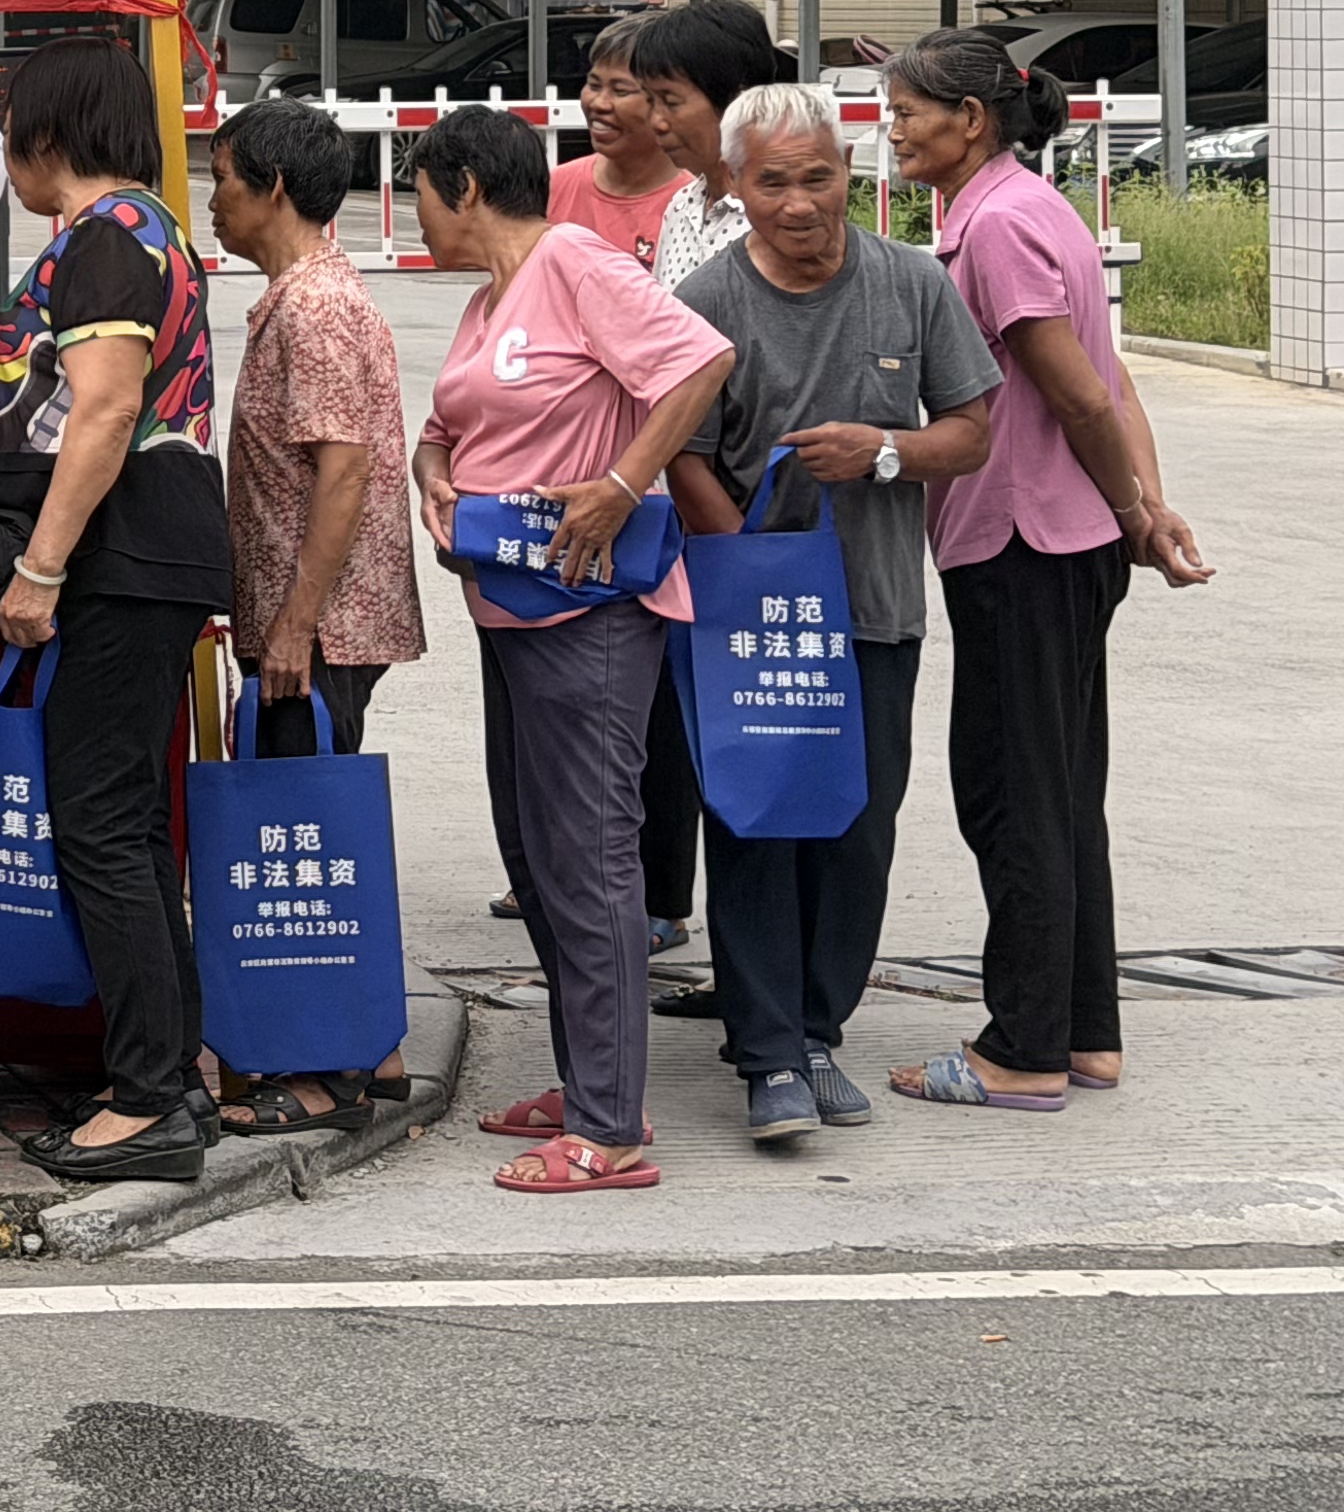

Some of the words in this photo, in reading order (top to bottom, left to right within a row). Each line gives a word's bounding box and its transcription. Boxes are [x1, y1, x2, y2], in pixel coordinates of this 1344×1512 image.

[493, 326, 528, 381] C
[762, 595, 824, 624] 防范
[729, 631, 845, 659] 非法集资
[733, 691, 845, 707] 0766-8612902
[260, 823, 322, 853] 防范
[229, 859, 357, 890] 非法集资
[257, 900, 332, 918] 举报电话:
[232, 920, 361, 939] 0766-8612902
